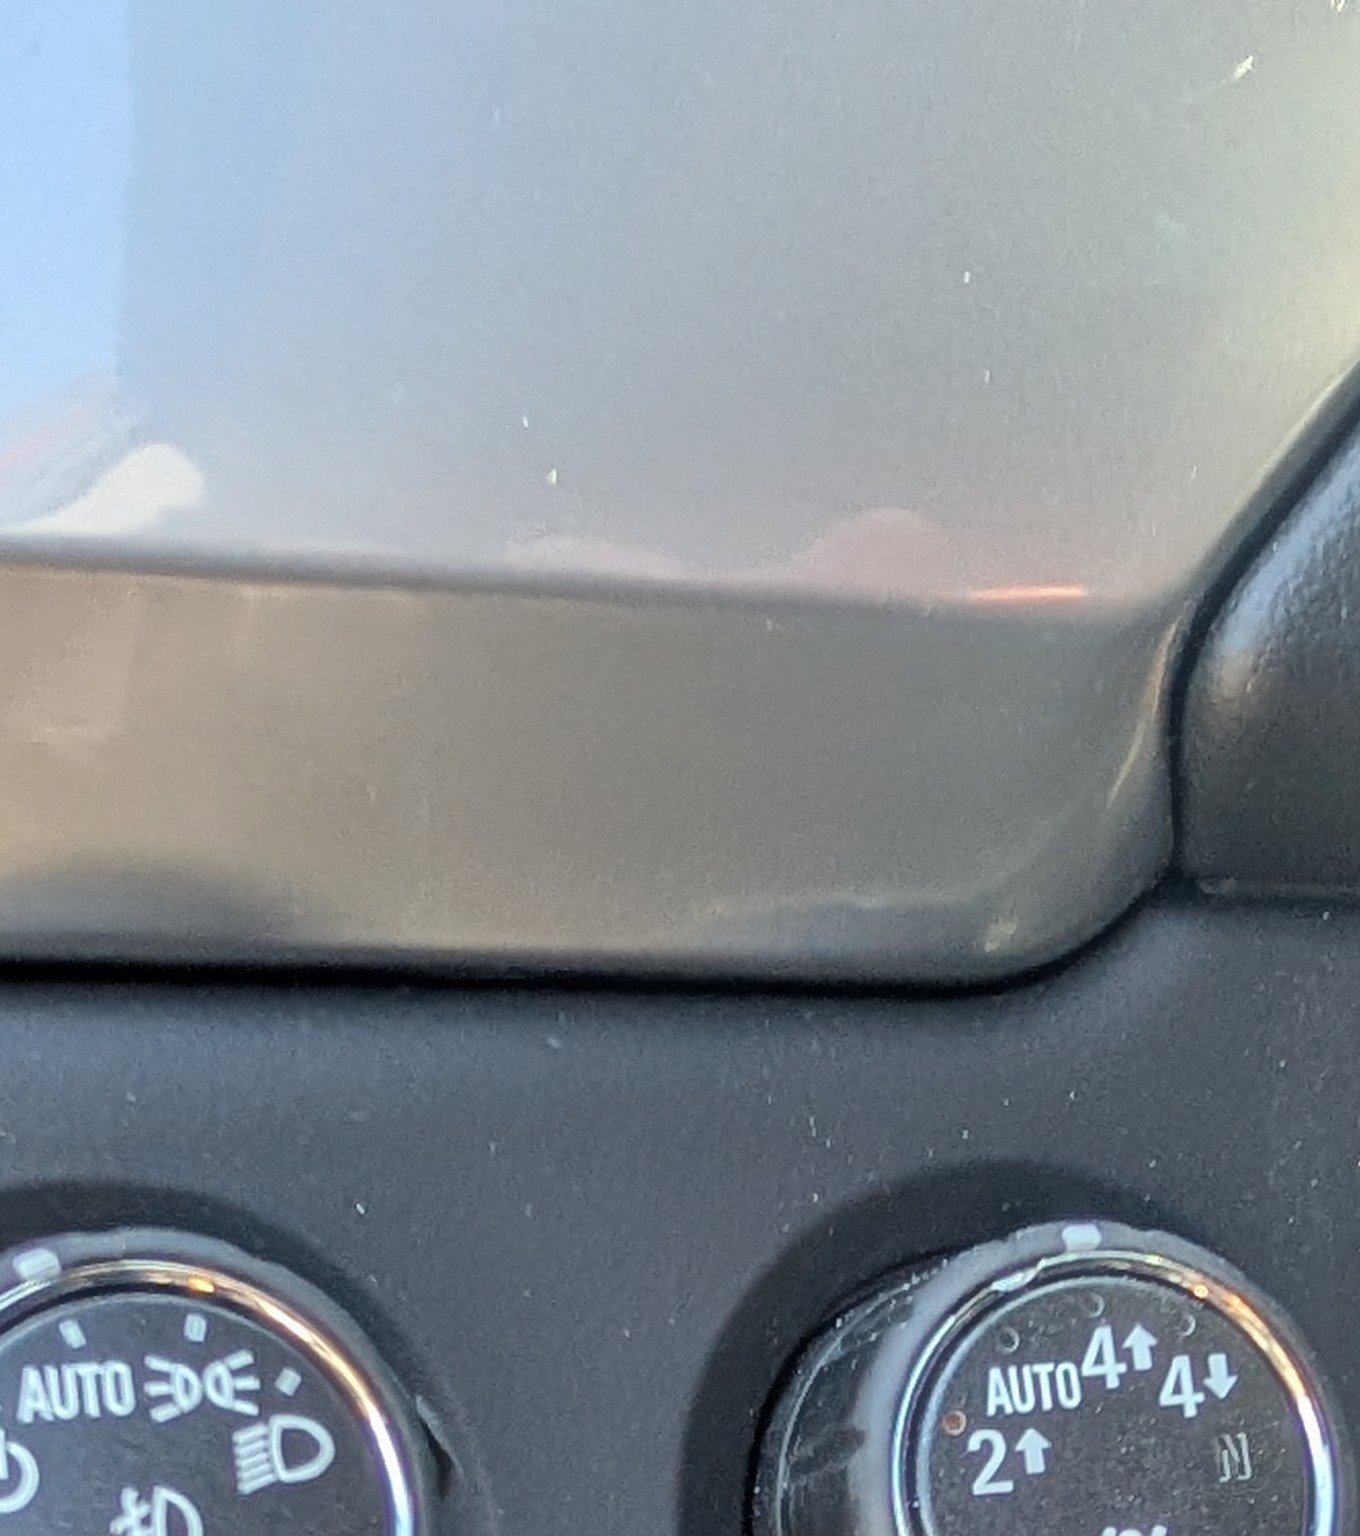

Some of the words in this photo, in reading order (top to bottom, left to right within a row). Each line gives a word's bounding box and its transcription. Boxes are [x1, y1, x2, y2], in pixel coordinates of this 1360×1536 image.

[986, 1361, 1082, 1417] AUTO
[1081, 1325, 1127, 1390] 4
[1159, 1354, 1205, 1418] 4
[17, 1360, 137, 1424] AUTO
[967, 1428, 1014, 1496] 2
